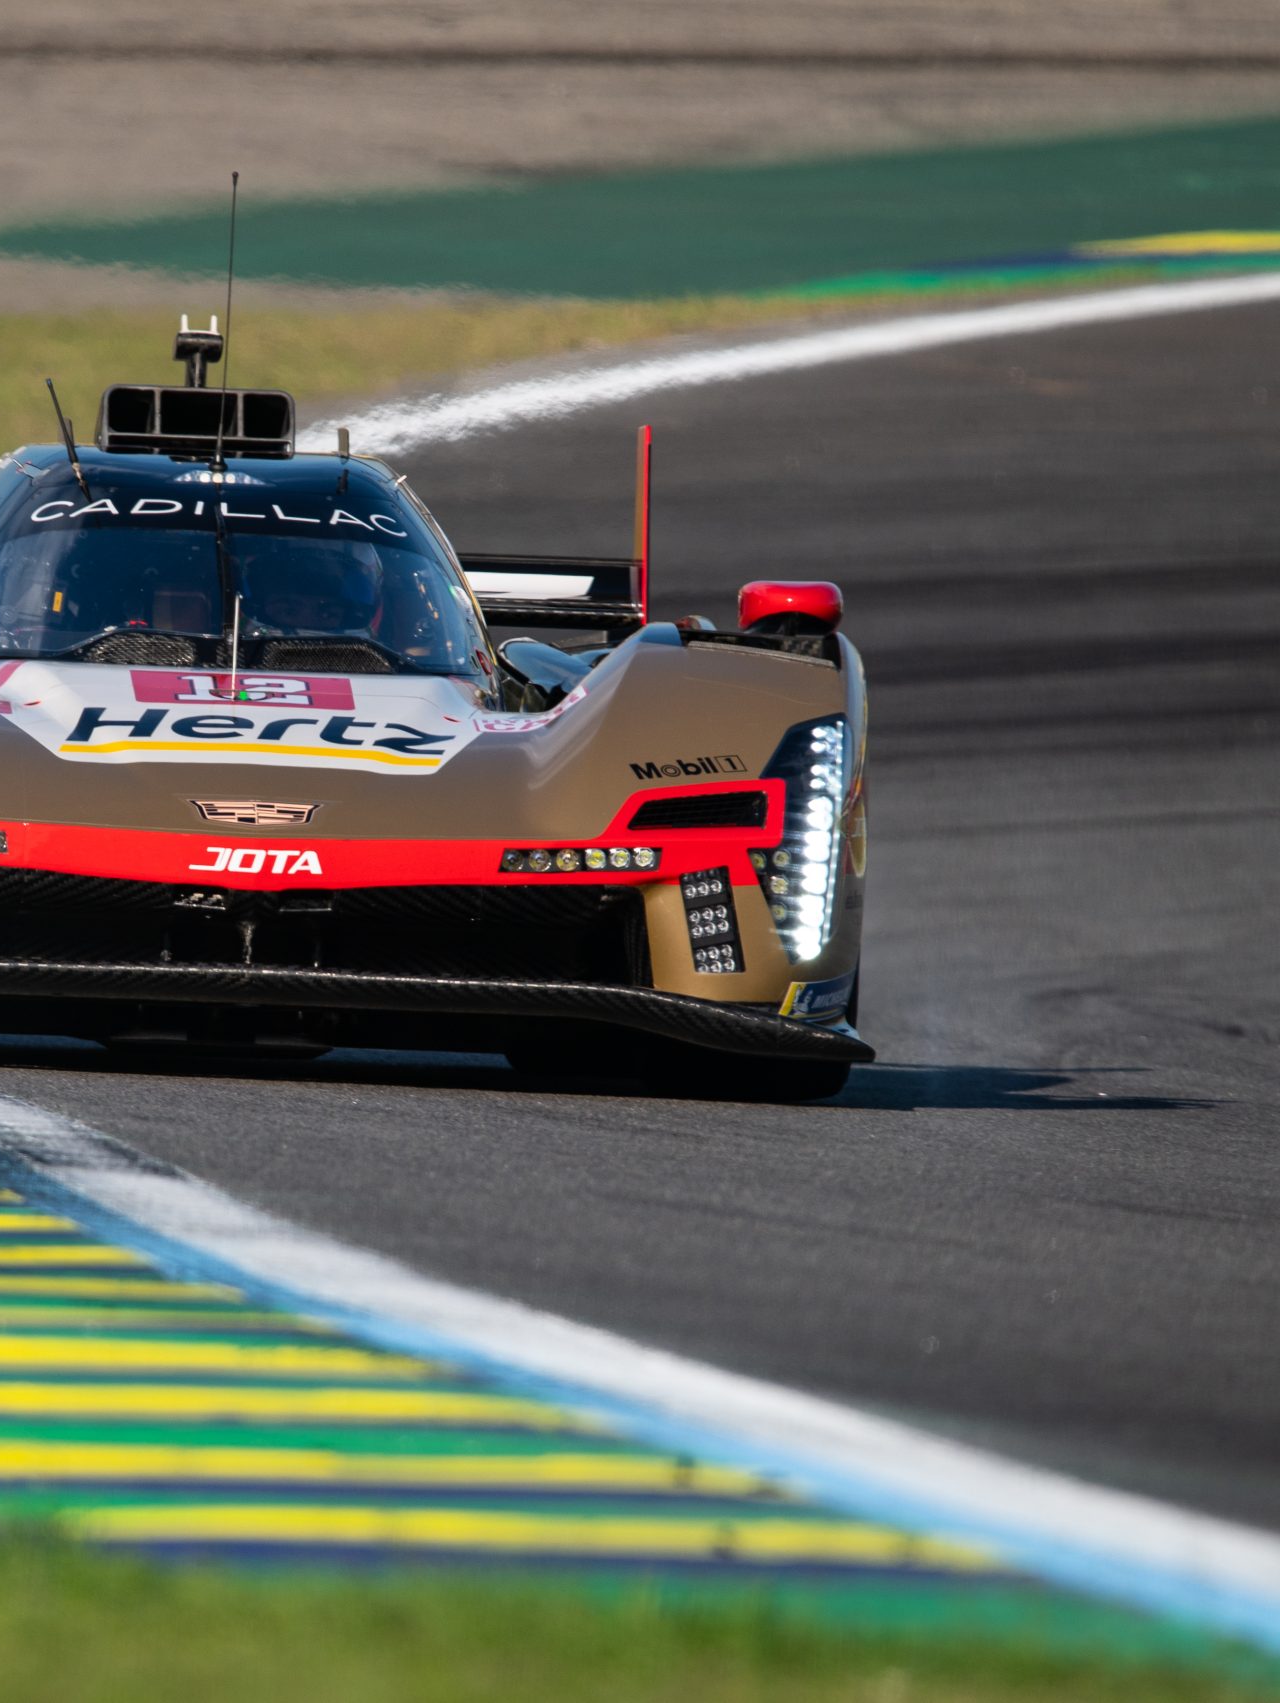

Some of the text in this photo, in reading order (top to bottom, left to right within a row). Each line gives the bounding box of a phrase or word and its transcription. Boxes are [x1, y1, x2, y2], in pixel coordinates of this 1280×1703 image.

[30, 498, 408, 538] CADILLAC
[175, 675, 312, 706] 12
[65, 706, 456, 756] Hertz
[629, 756, 719, 780] Mobil
[188, 846, 323, 875] JOTA
